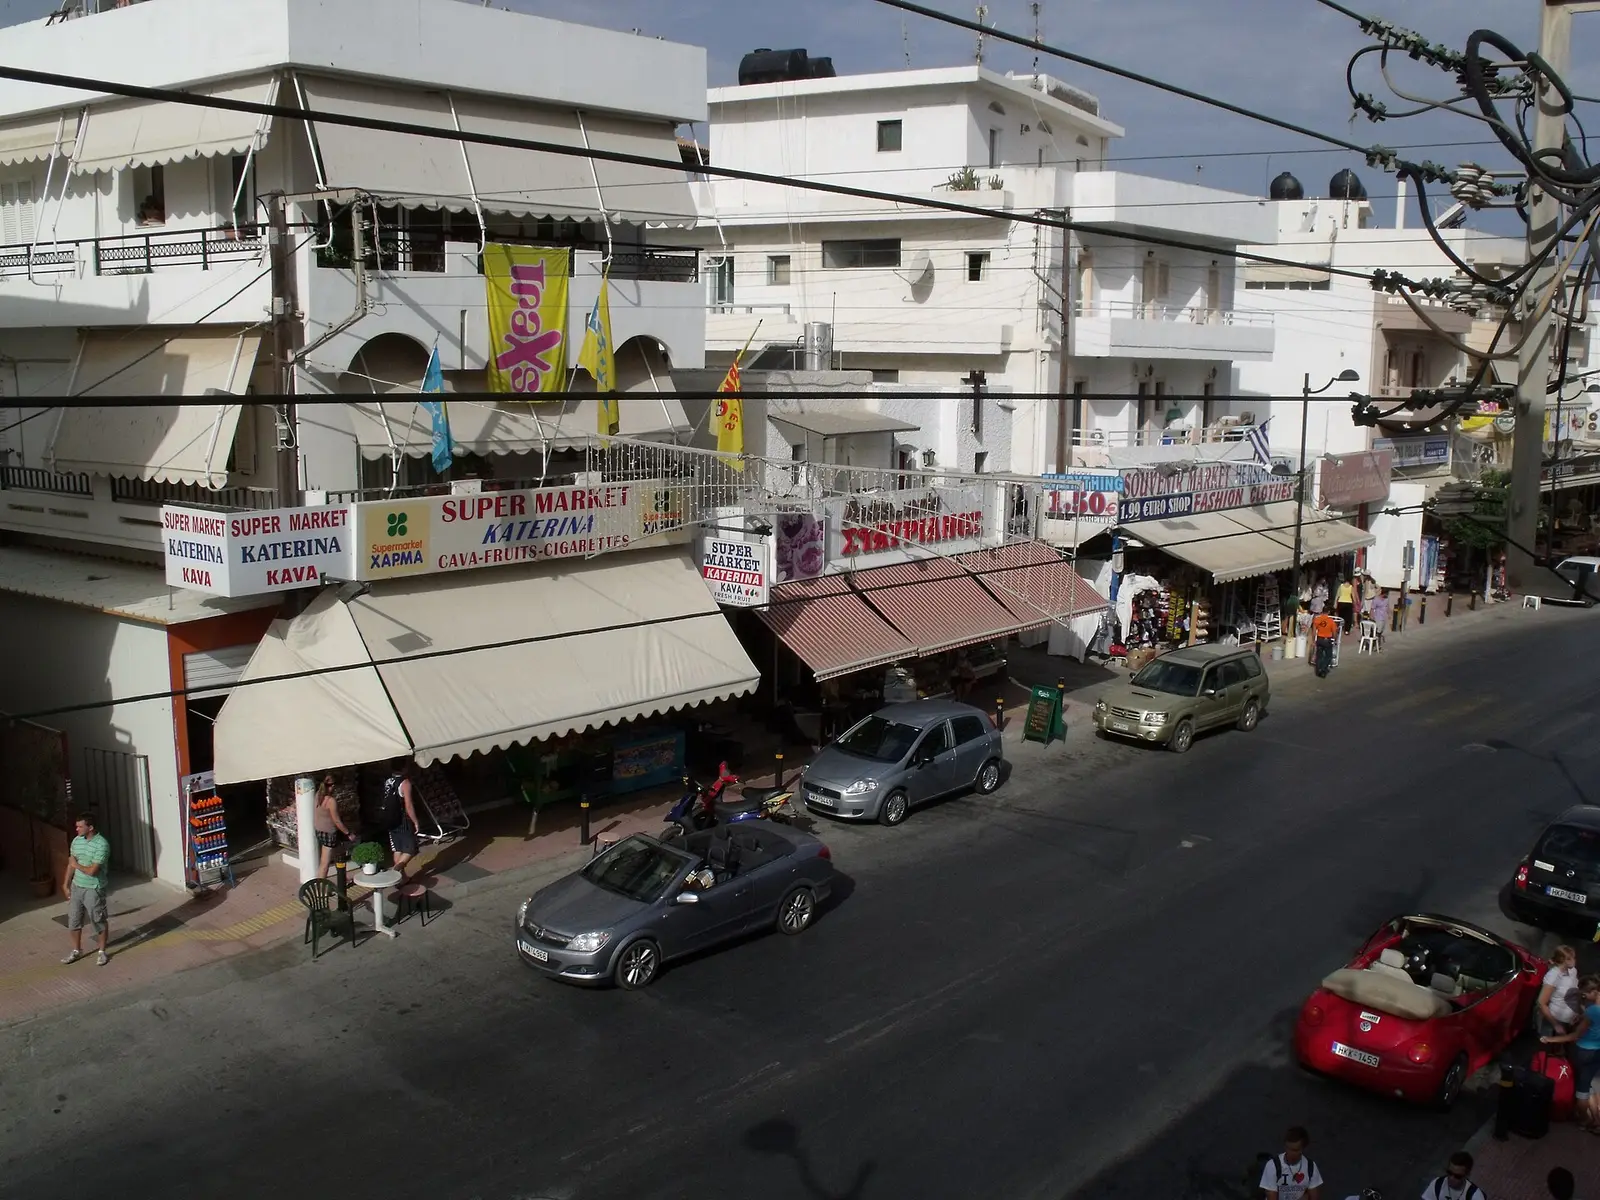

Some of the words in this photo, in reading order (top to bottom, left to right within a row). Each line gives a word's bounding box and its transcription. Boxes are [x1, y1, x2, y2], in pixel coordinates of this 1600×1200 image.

[1187, 464, 1231, 492] MARKET
[440, 496, 525, 523] SUPER
[535, 486, 629, 514] MARKET
[1120, 502, 1140, 519] 1.99
[1168, 496, 1191, 513] SHOP
[1193, 488, 1244, 512] FASHION
[1250, 482, 1293, 503] CLOTHES
[164, 511, 190, 530] SUPER
[192, 516, 226, 538] MARKET
[231, 515, 281, 537] SUPER
[289, 509, 348, 531] MARKET
[481, 514, 594, 544] KATERINA
[169, 539, 224, 564] KATERINA
[241, 536, 342, 564] KATERINA
[372, 540, 423, 554] Supermarket
[711, 542, 753, 558] SUPER
[705, 553, 760, 572] MARKET
[182, 567, 212, 587] KAVA
[266, 565, 318, 586] KAVA
[706, 568, 760, 585] KATERINA
[720, 583, 743, 595] KAVA
